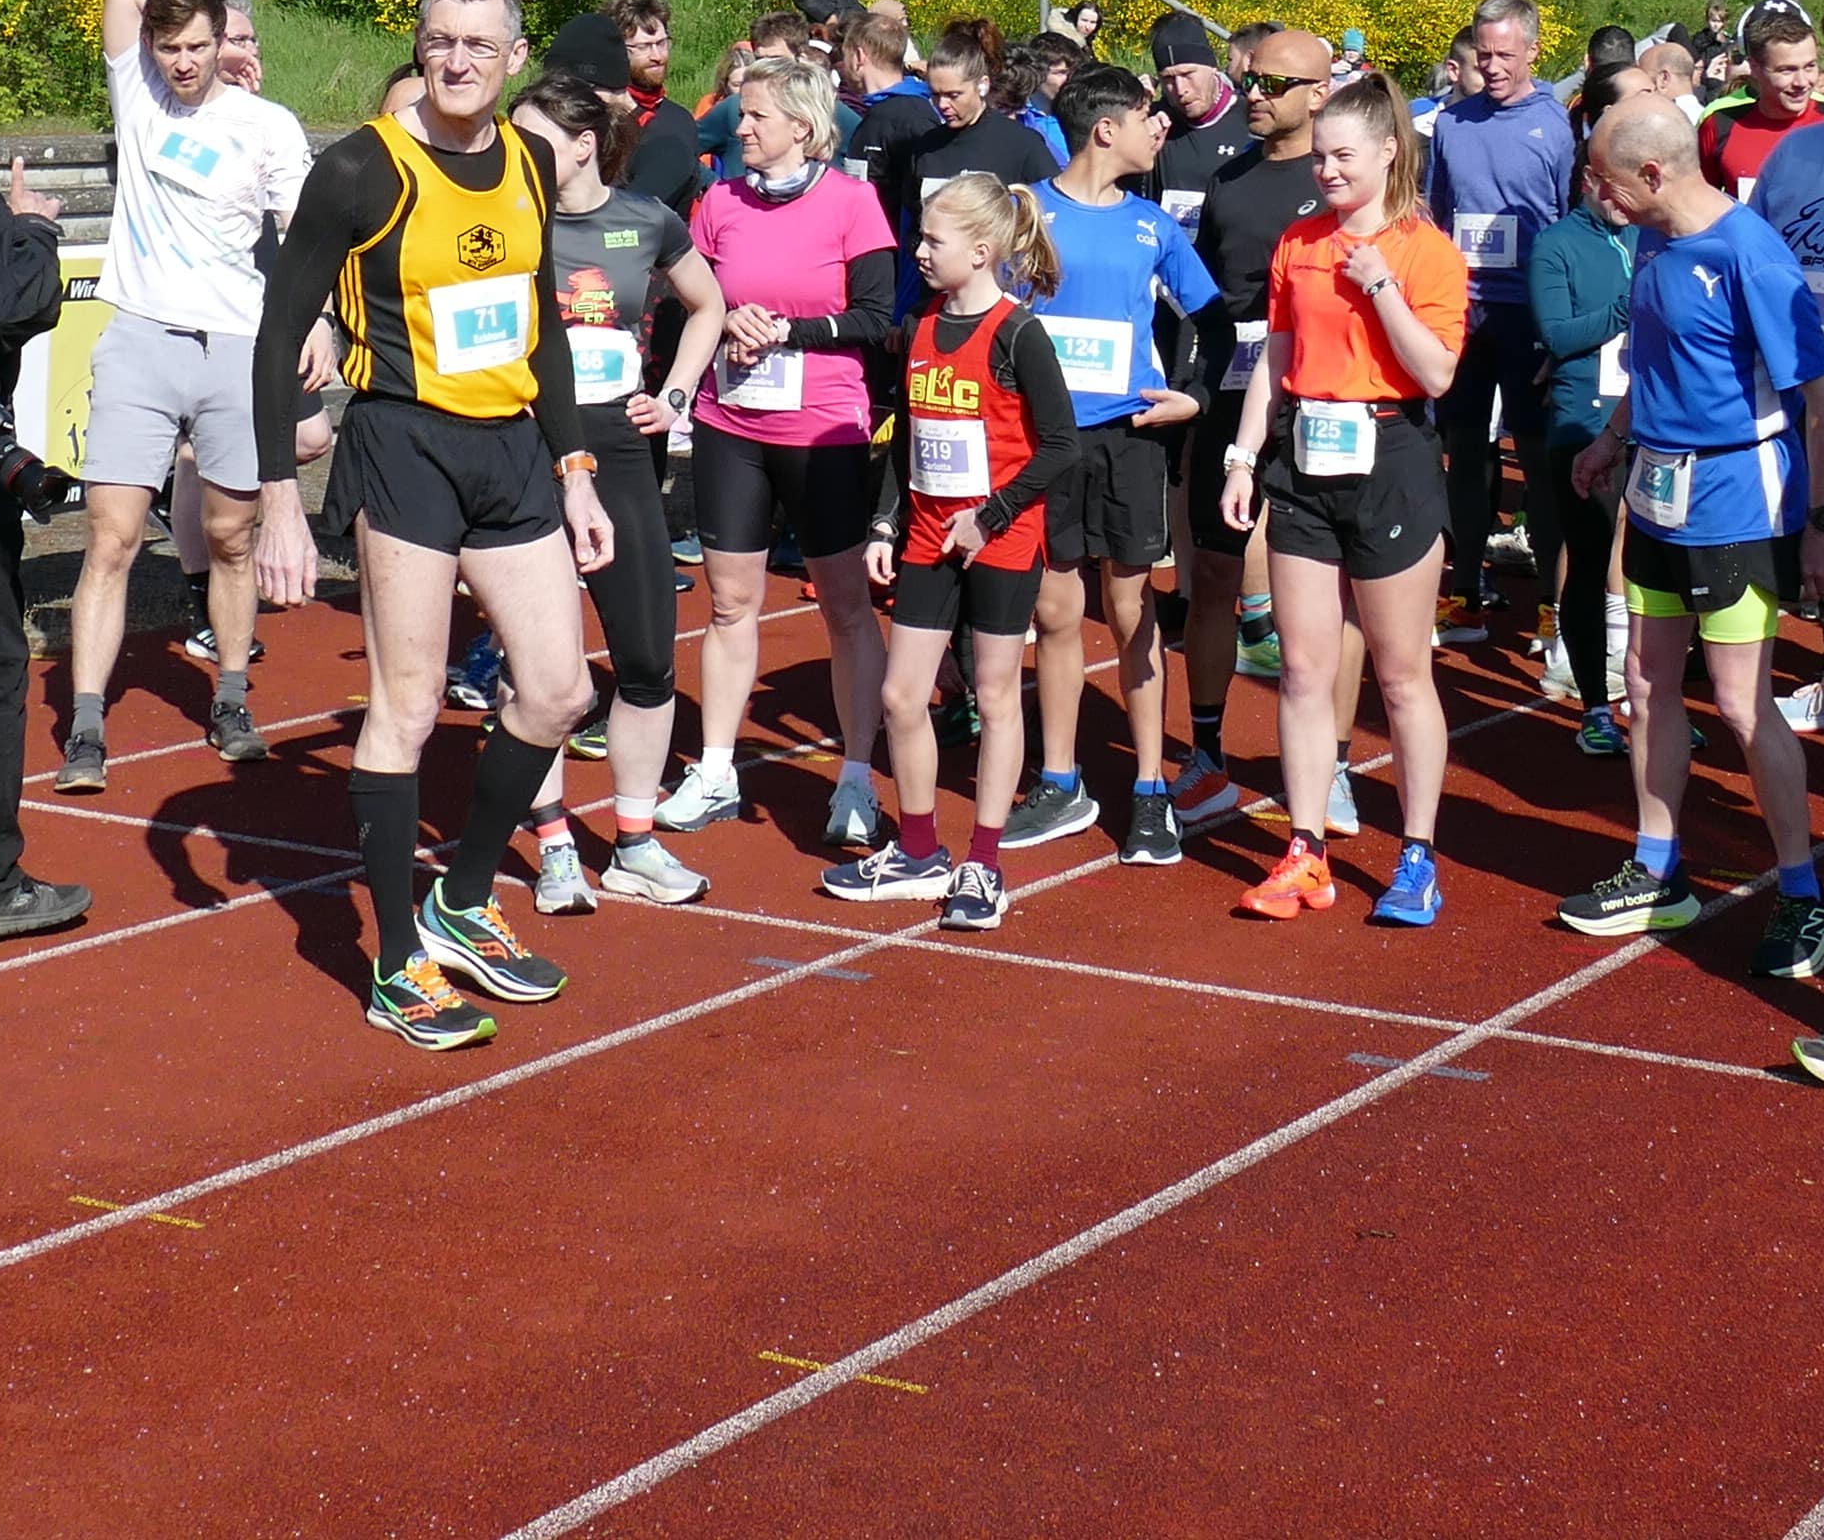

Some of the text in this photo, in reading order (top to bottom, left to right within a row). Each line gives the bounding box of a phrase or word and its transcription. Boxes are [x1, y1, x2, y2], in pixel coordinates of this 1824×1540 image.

[1469, 231, 1493, 244] 160
[475, 306, 497, 330] 71
[1064, 337, 1100, 357] 124
[909, 366, 980, 409] BLC
[1308, 418, 1341, 439] 125
[920, 441, 952, 460] 219
[1600, 888, 1671, 912] new balance
